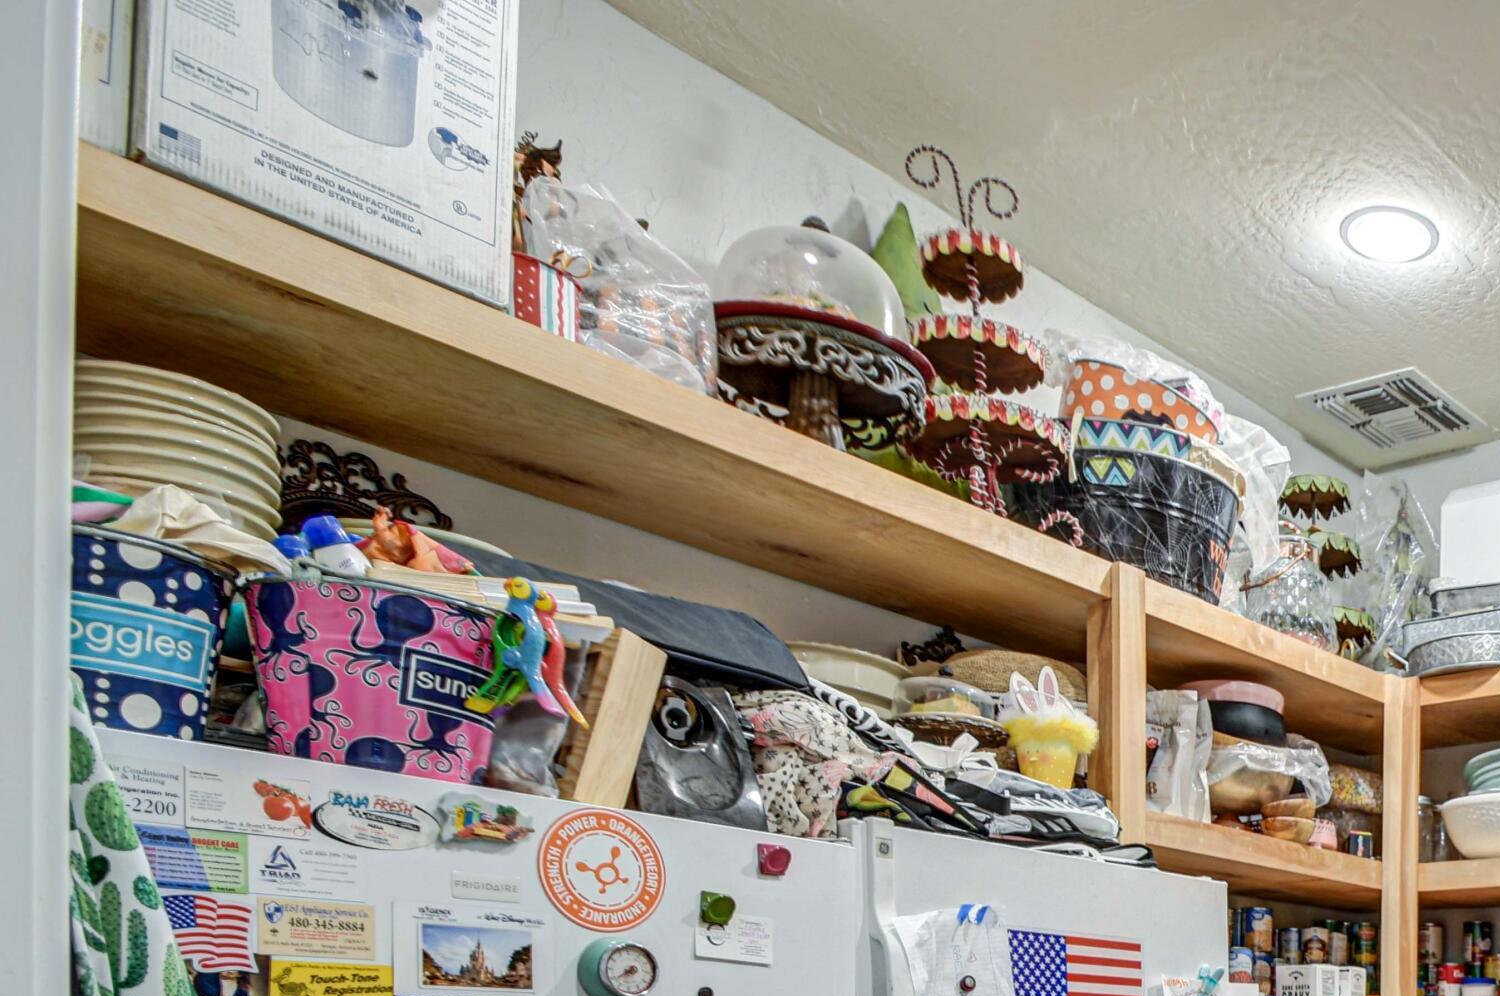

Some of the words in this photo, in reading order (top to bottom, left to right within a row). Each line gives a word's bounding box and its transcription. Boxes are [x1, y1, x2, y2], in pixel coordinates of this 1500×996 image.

[261, 150, 313, 178] DESIGNED
[315, 174, 335, 188] AND
[337, 183, 415, 223] MANUFACTURED
[254, 157, 265, 169] IN
[267, 163, 287, 178] THE
[290, 173, 326, 195] UNITED
[328, 189, 364, 212] STATES
[365, 206, 380, 217] OF
[381, 213, 423, 237] AMERICA
[71, 618, 193, 664] oggles
[123, 766, 179, 780] Conditioning
[133, 774, 165, 785] Heating
[331, 791, 369, 808] BAJA
[559, 816, 598, 840] POWER
[608, 819, 658, 895] ORANGETHEORY
[547, 847, 573, 905] STRENGTH
[454, 880, 519, 893] FRIGIDAIRE
[580, 900, 648, 924] ENDURANCE
[288, 917, 365, 932] 480-345-8884
[310, 973, 379, 984] Touch-Tone
[323, 985, 393, 996] Registration
